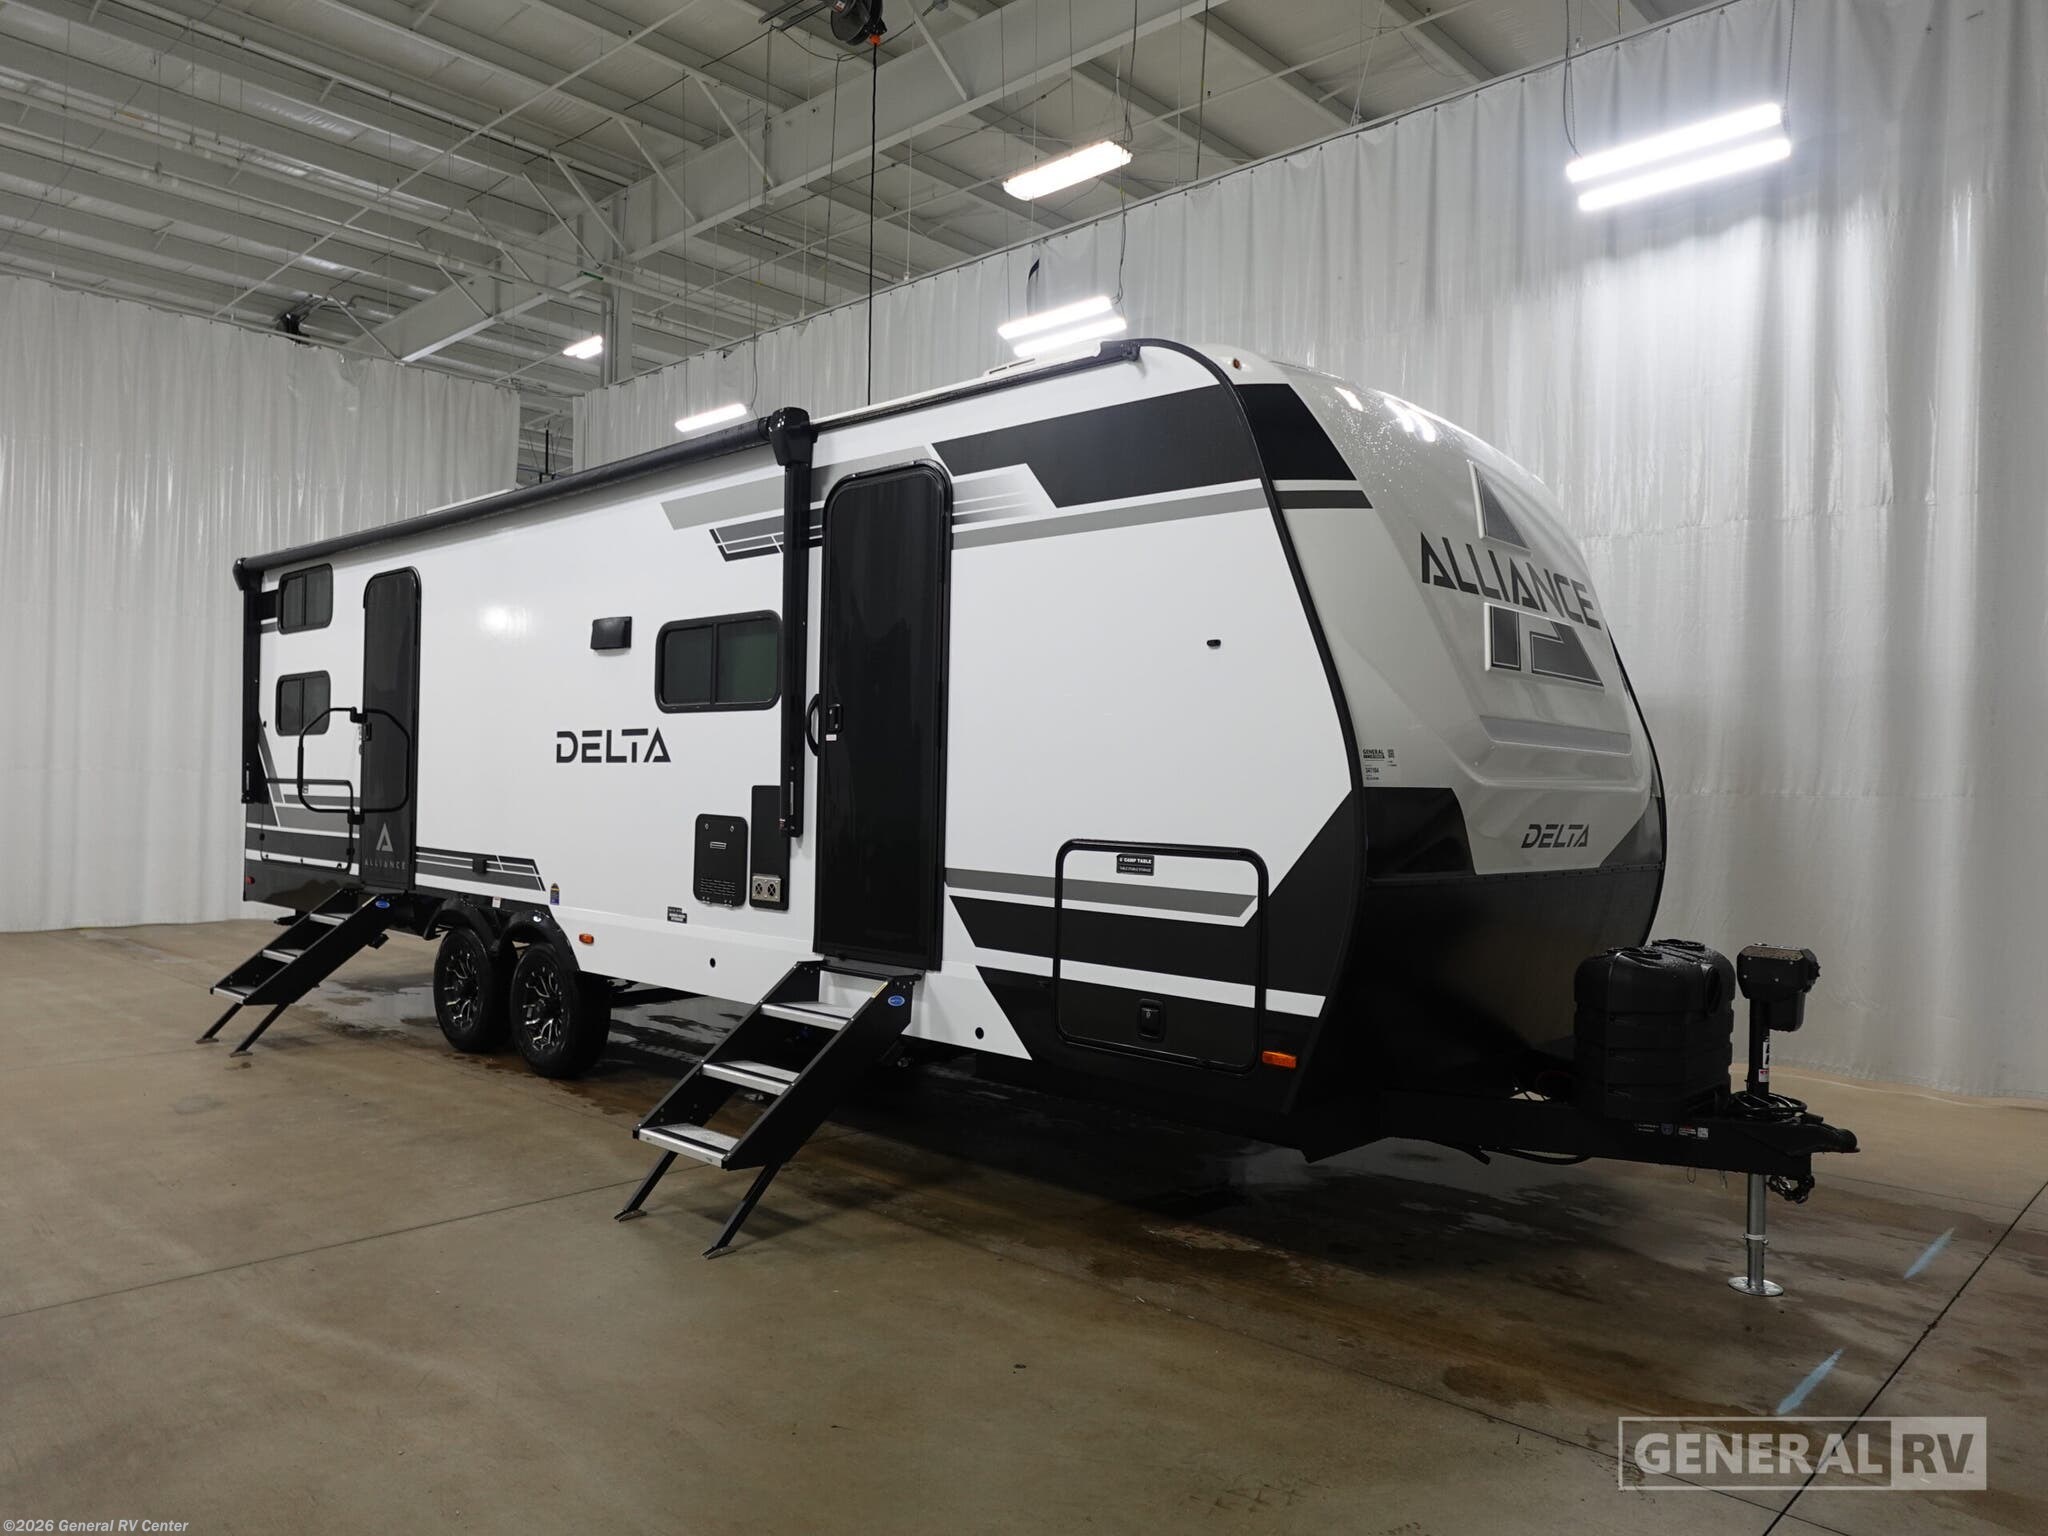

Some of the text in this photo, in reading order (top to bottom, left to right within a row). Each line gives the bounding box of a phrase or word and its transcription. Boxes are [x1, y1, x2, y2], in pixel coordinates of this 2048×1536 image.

[1421, 531, 1602, 631] ALLIANCE
[556, 727, 672, 763] DELTA
[1521, 824, 1589, 848] DELTA
[364, 859, 406, 870] ALLIANCE
